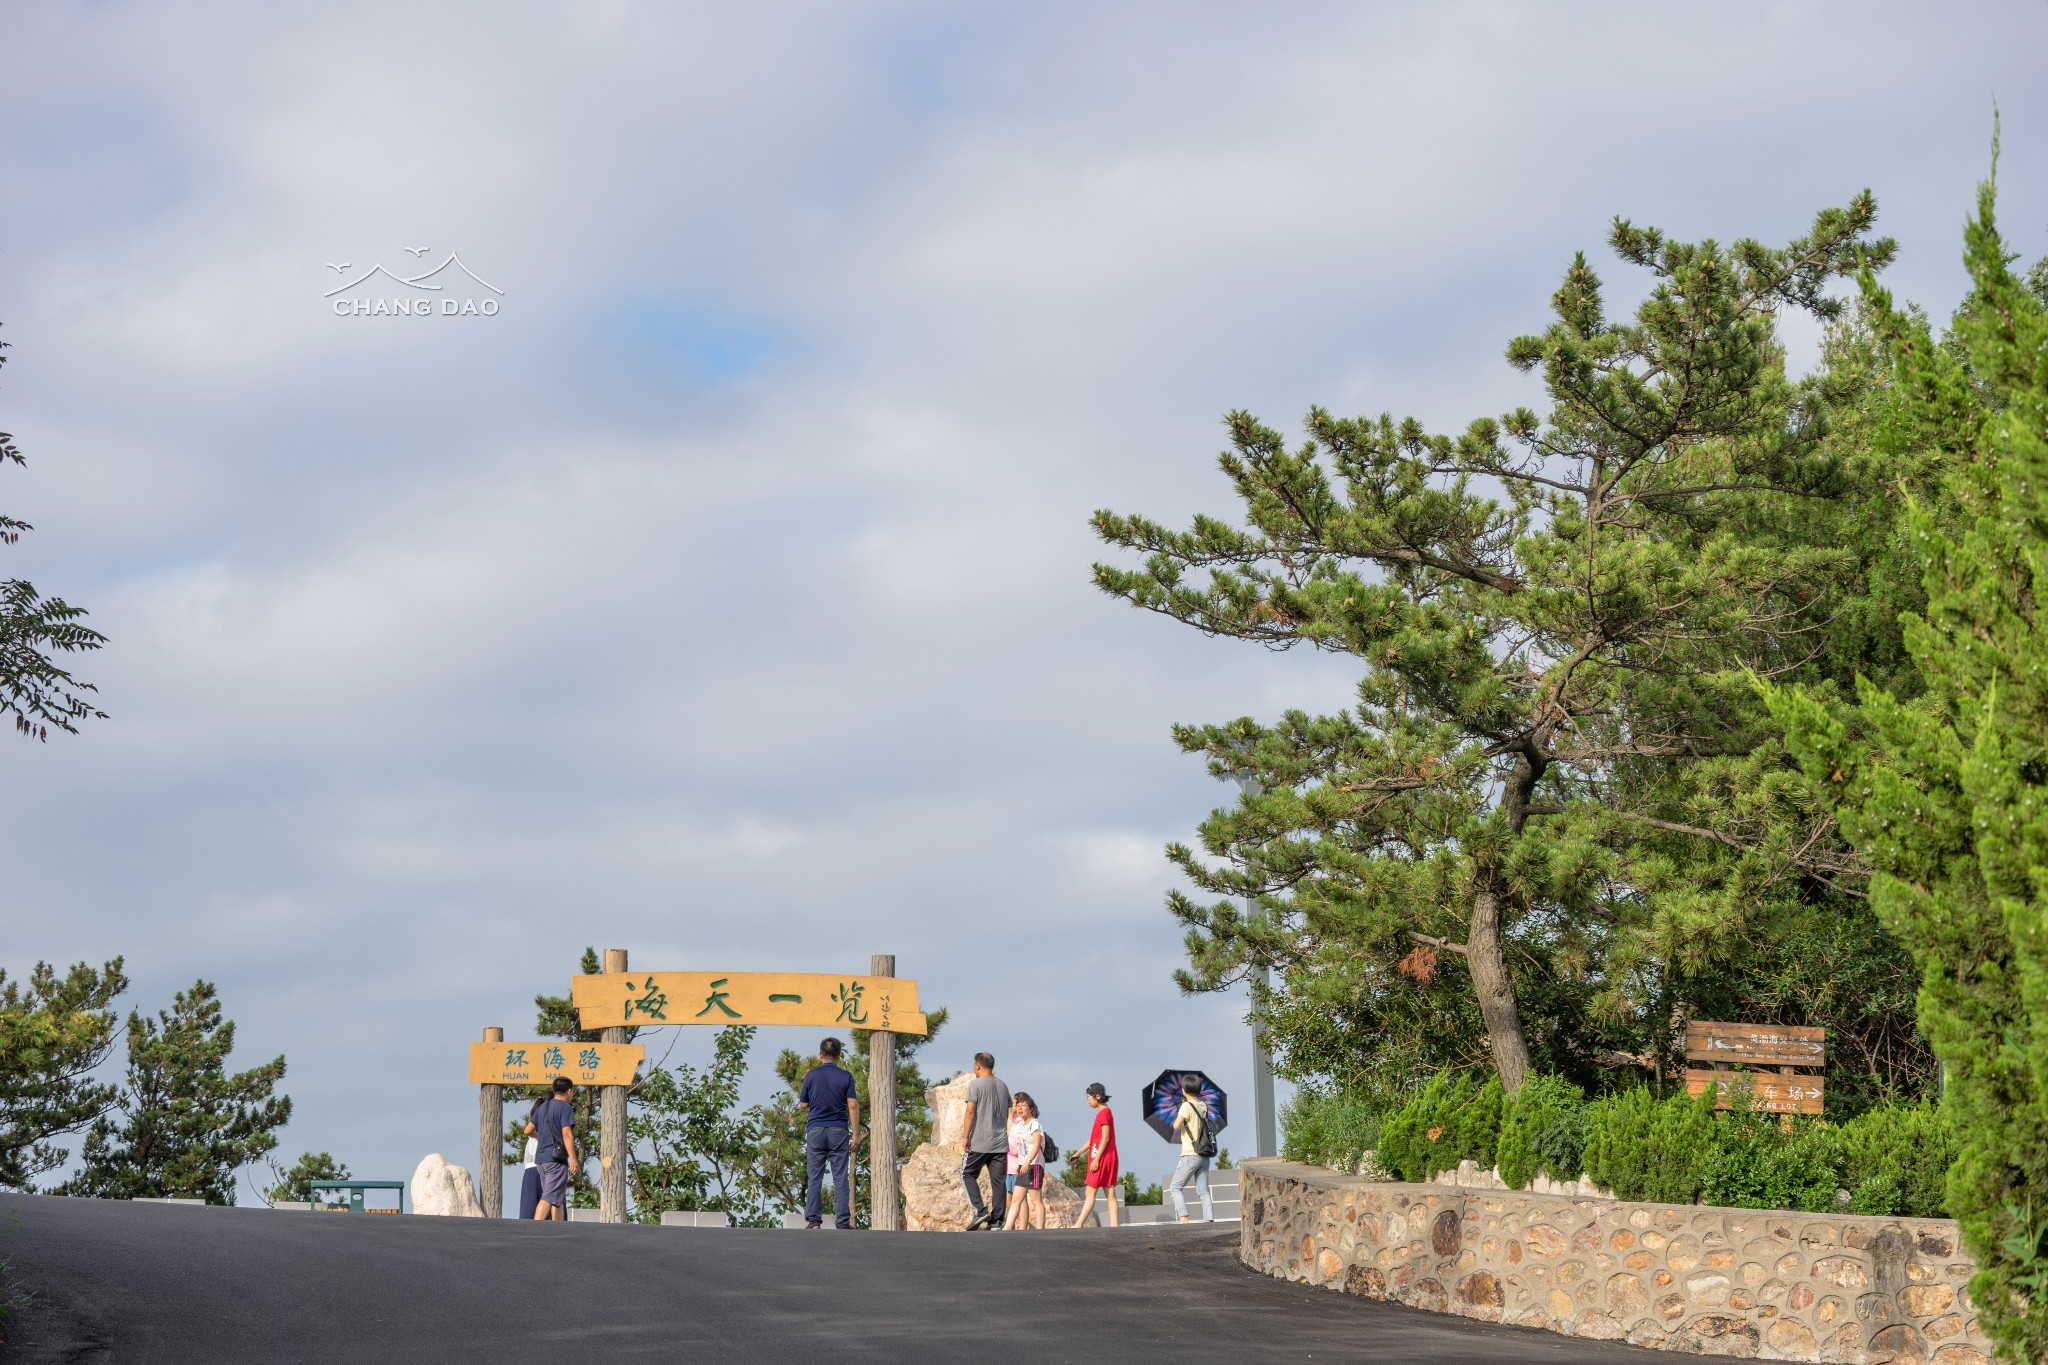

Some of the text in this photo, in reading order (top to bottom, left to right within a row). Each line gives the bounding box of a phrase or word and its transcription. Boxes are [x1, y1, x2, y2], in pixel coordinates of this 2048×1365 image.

[623, 976, 870, 1024] 海天一览
[505, 1046, 602, 1070] 环海路
[502, 1072, 529, 1080] HUAN
[582, 1072, 595, 1080] LU
